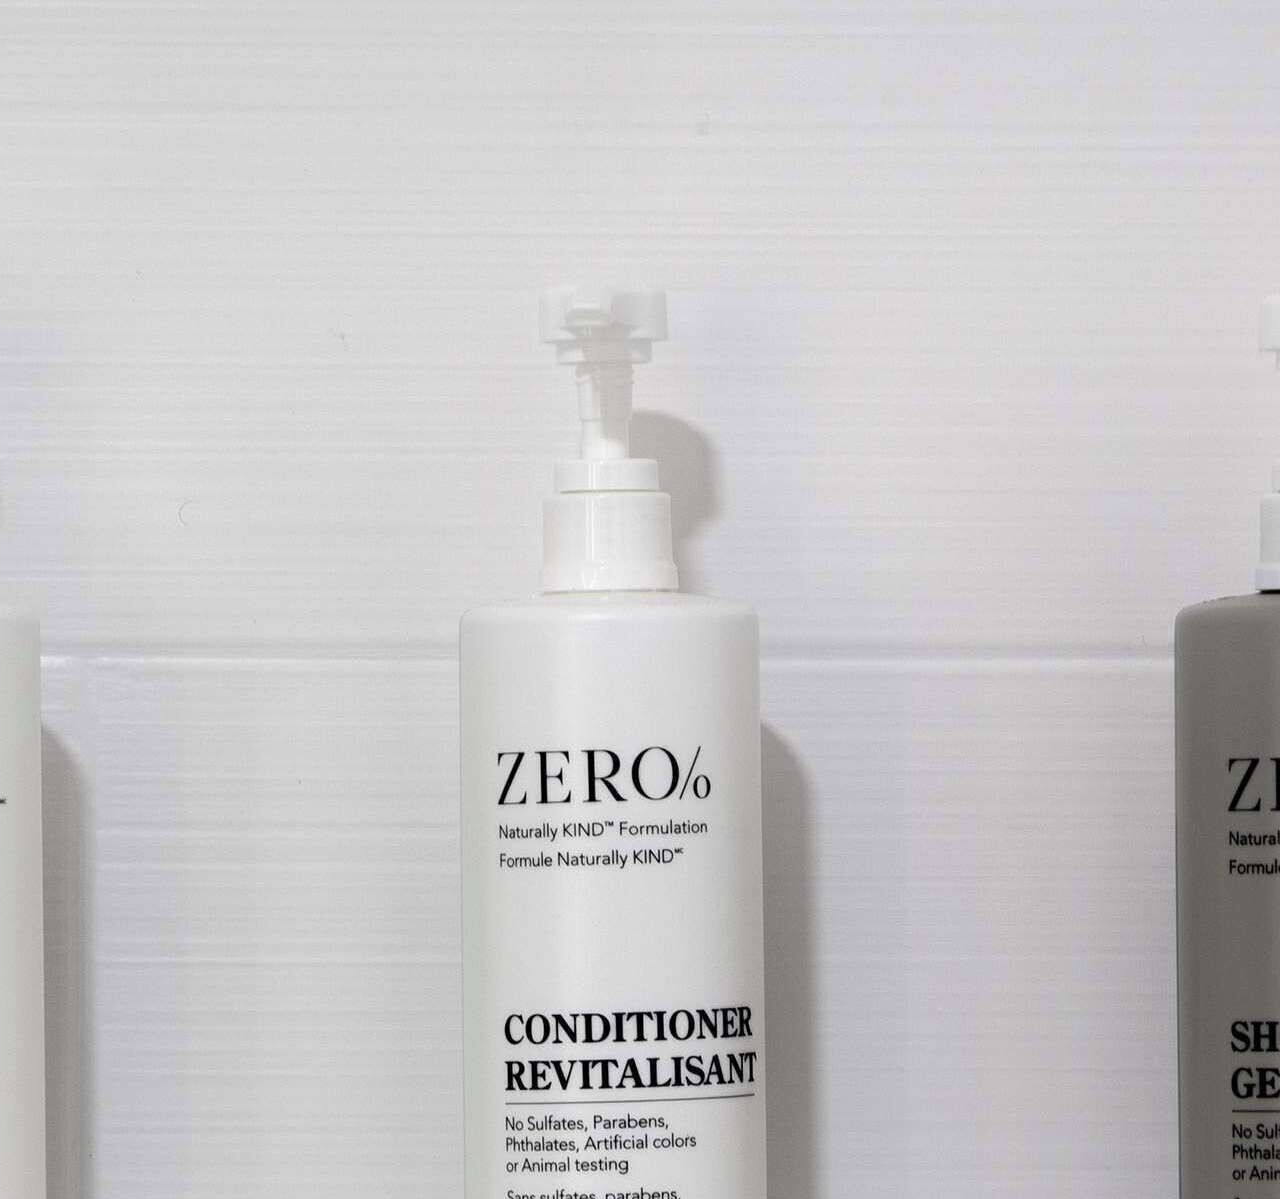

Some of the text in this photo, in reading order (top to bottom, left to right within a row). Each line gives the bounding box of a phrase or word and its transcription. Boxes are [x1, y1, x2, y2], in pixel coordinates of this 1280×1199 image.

[499, 822, 557, 842] Naturally
[619, 820, 708, 835] Formulation
[499, 853, 553, 868] Formule
[557, 852, 628, 869] Naturally
[504, 1006, 753, 1045] CONDITIONER
[504, 1051, 757, 1090] REVITALISANT
[505, 1114, 669, 1132] No Sulfates, Parabens,
[1232, 1124, 1252, 1139] No
[506, 1133, 697, 1153] Phthalates, Artificial colors
[506, 1157, 629, 1174] or Animal testing
[1232, 1170, 1246, 1180] or
